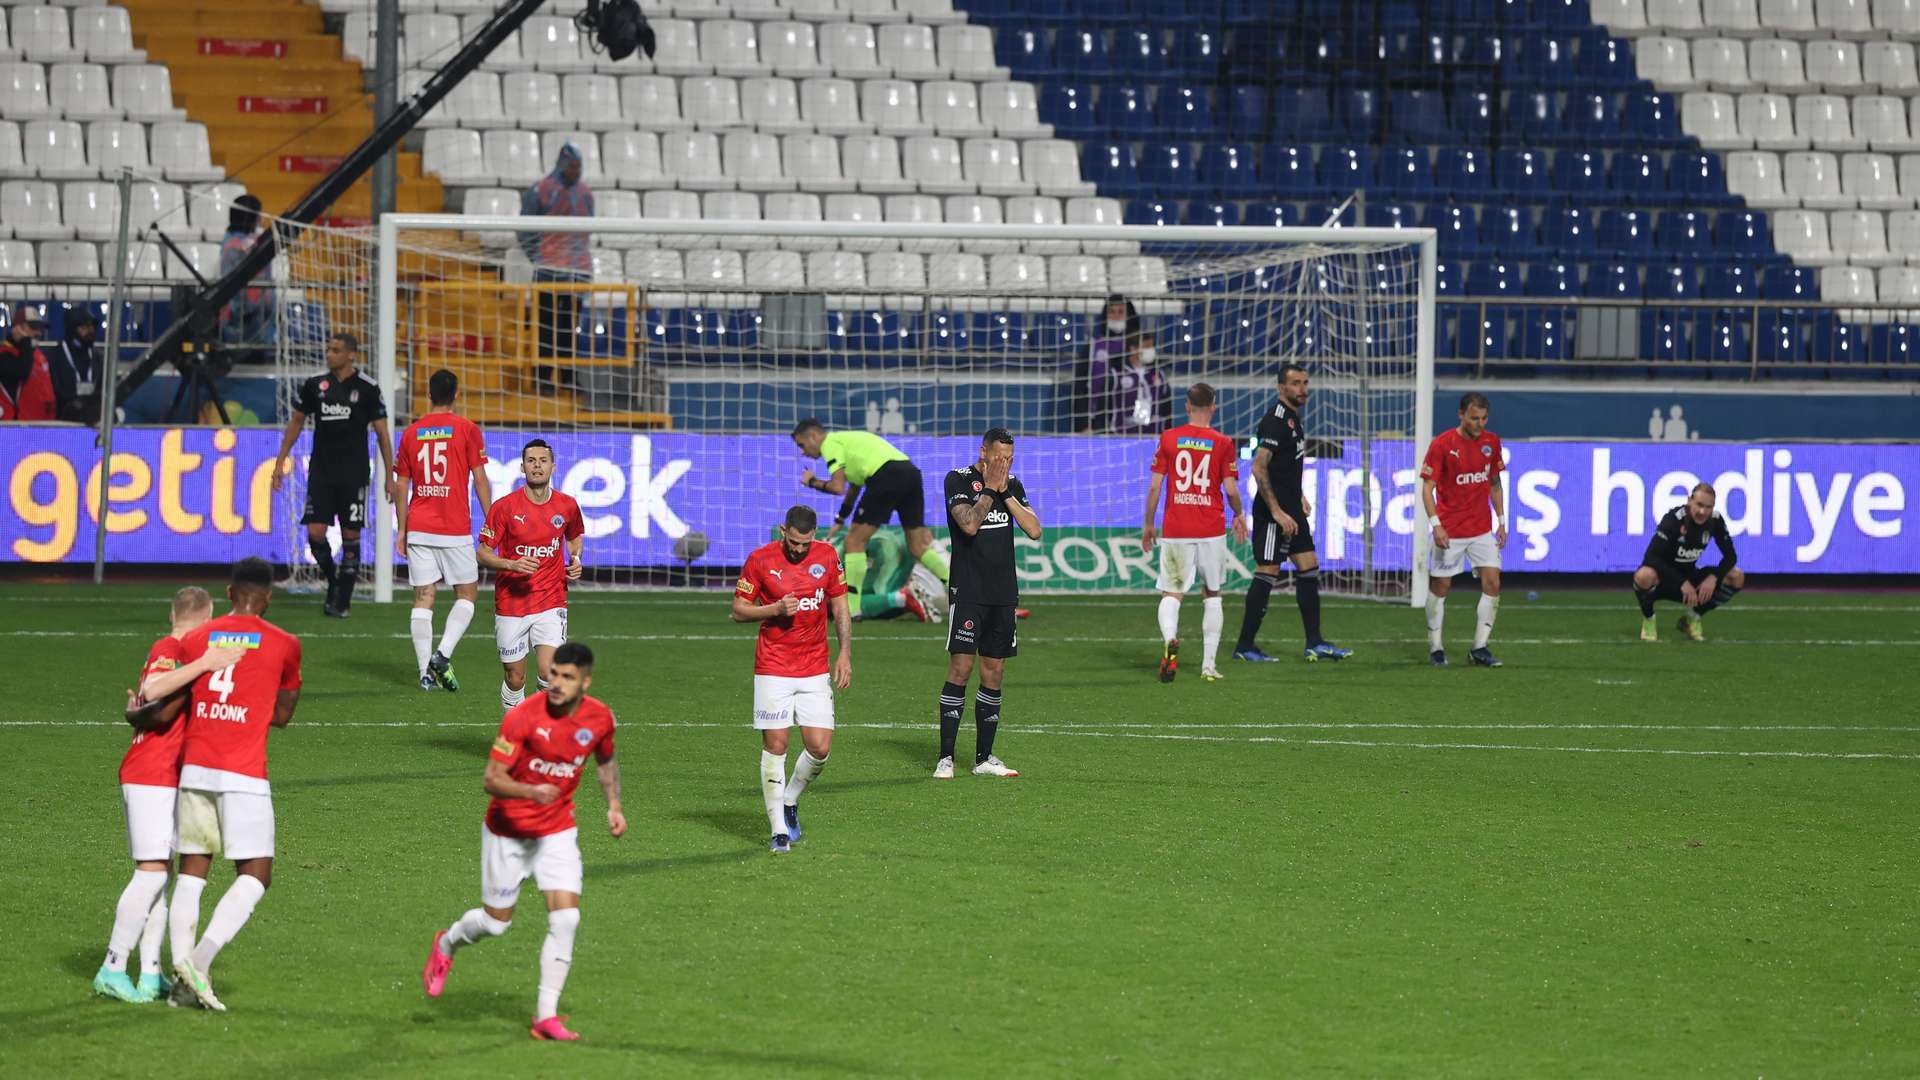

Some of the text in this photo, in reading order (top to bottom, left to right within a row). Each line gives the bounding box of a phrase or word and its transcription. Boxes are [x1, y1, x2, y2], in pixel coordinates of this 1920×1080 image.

[321, 402, 352, 415] beko
[417, 441, 448, 485] 15
[1175, 449, 1211, 494] 94
[10, 428, 293, 562] getir
[417, 485, 450, 497] SERBEST
[1591, 448, 1905, 562] hediye
[983, 509, 1009, 523] eko
[208, 662, 235, 702] 4
[196, 702, 248, 722] R. DONK
